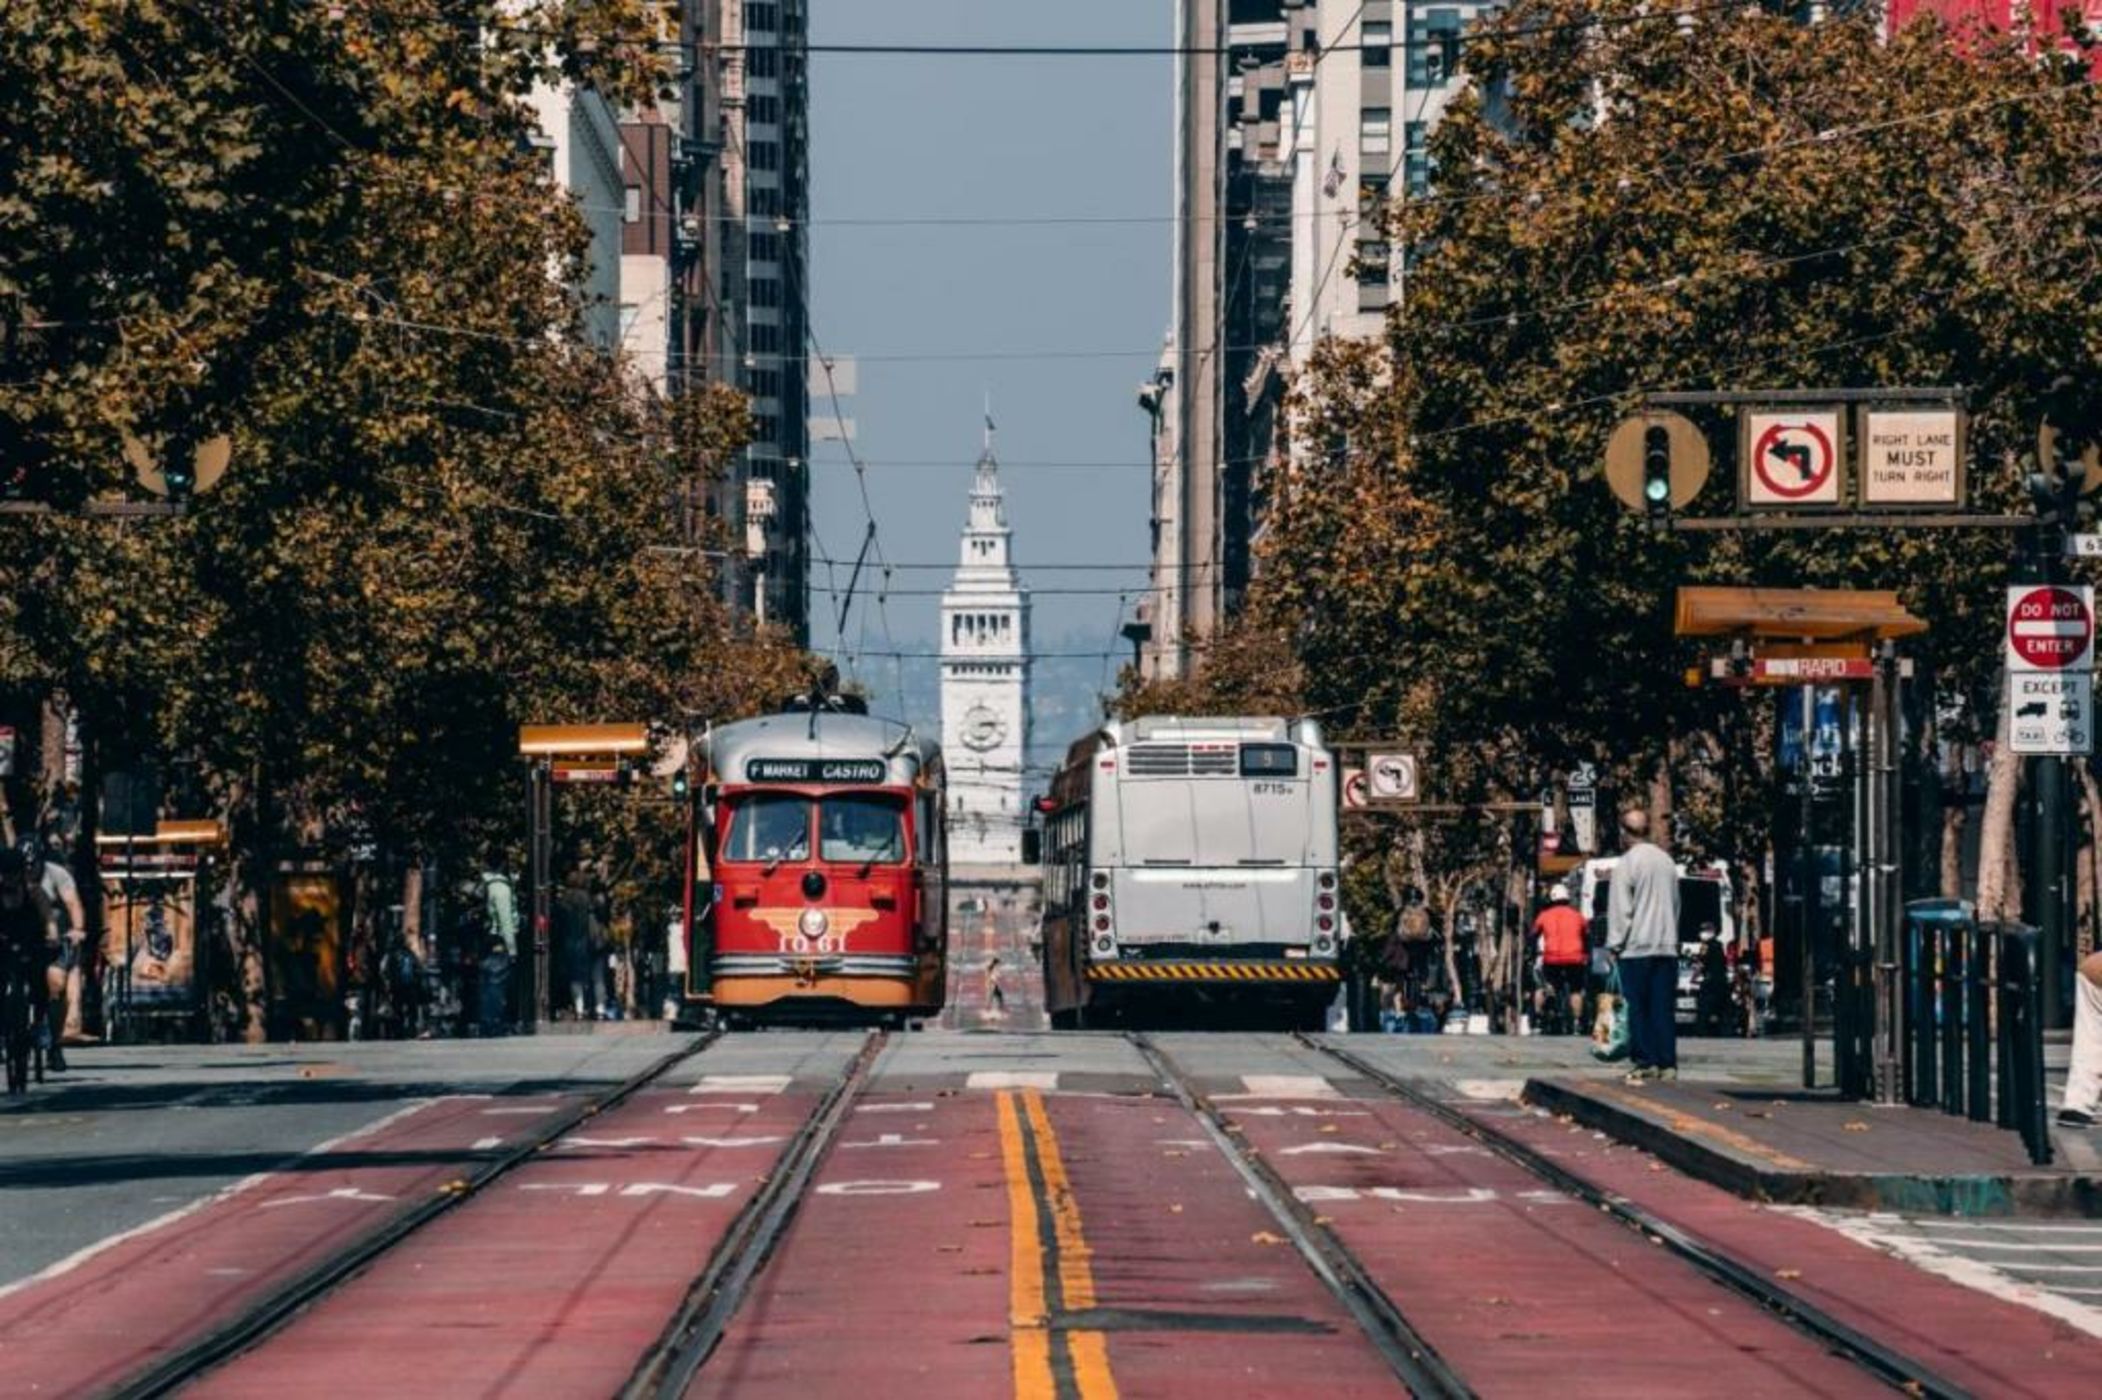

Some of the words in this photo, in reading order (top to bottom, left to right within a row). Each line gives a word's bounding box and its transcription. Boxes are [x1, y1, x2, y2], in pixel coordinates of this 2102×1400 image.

[1872, 434, 1908, 446] RIGHT
[1916, 434, 1952, 446] LANE
[1887, 450, 1936, 467] MUST
[1873, 470, 1906, 482] TURN
[1913, 470, 1950, 482] RIGHT
[2020, 603, 2042, 617] DO
[2050, 603, 2079, 617] NOT
[2026, 639, 2074, 653] ENTER
[1799, 658, 1847, 677] RAPID
[2023, 681, 2077, 694] EXCEPT
[751, 763, 760, 777] F
[763, 763, 808, 777] MARKET
[822, 763, 880, 779] CASTRO
[779, 936, 846, 953] 1061
